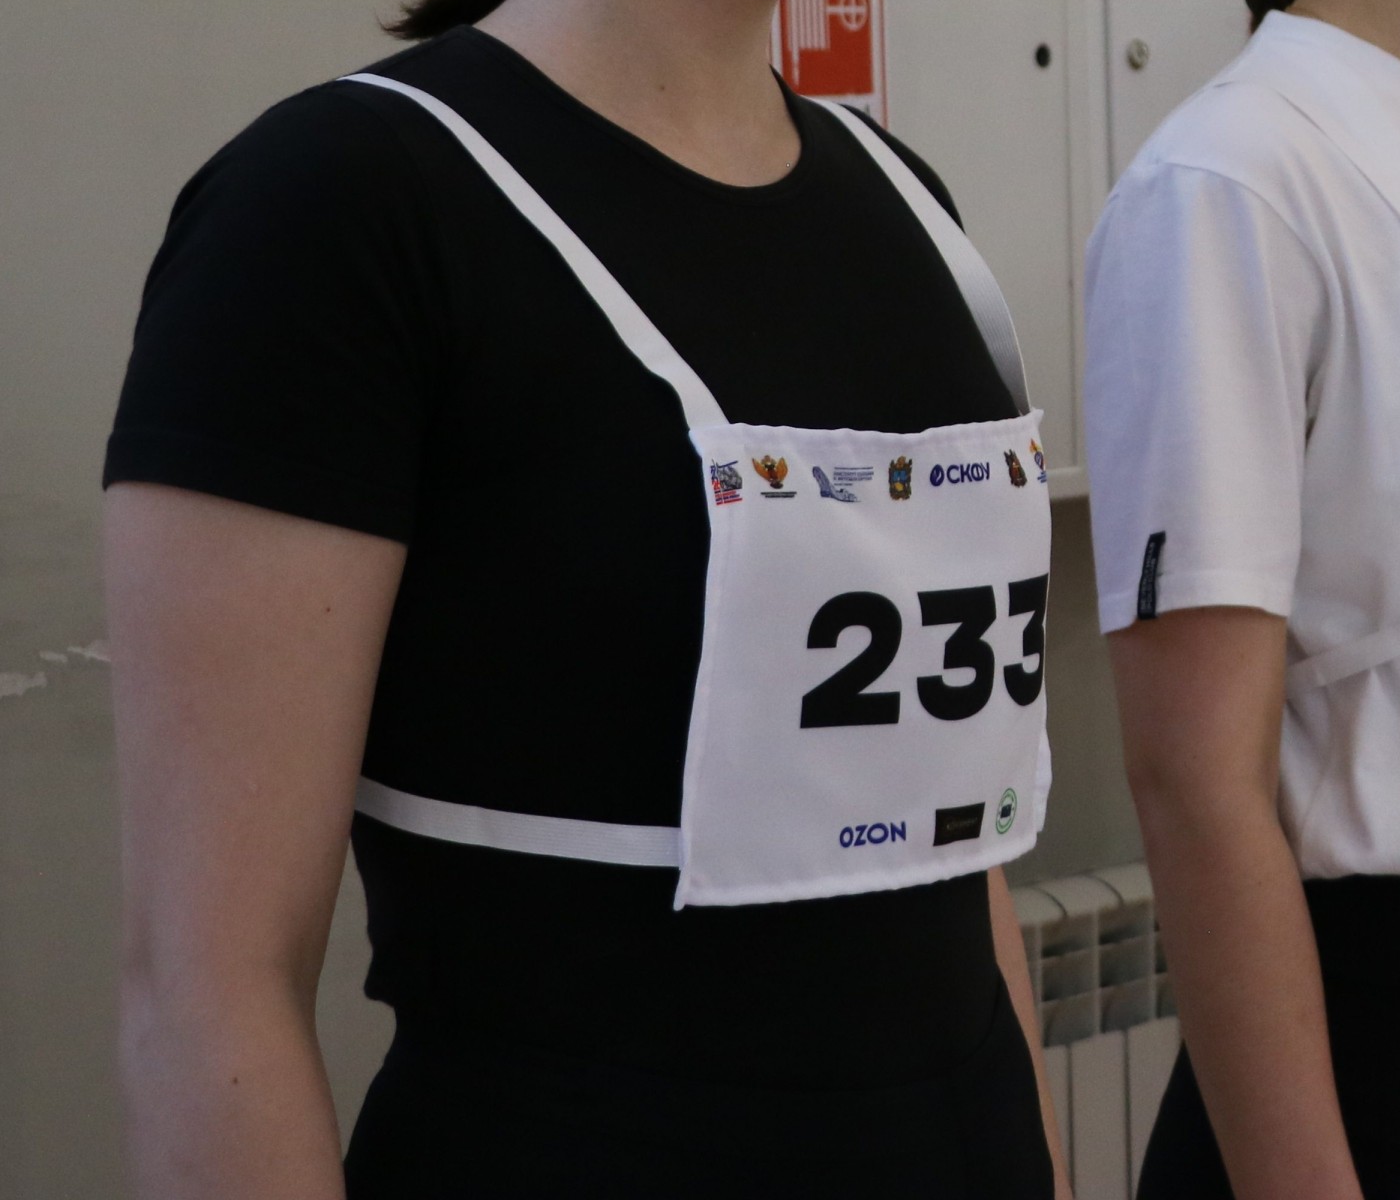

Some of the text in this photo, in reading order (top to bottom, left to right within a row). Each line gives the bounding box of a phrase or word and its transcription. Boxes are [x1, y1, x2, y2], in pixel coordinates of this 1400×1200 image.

[946, 462, 991, 484] СКФУ
[800, 573, 1049, 729] 233
[839, 820, 907, 849] OZON
